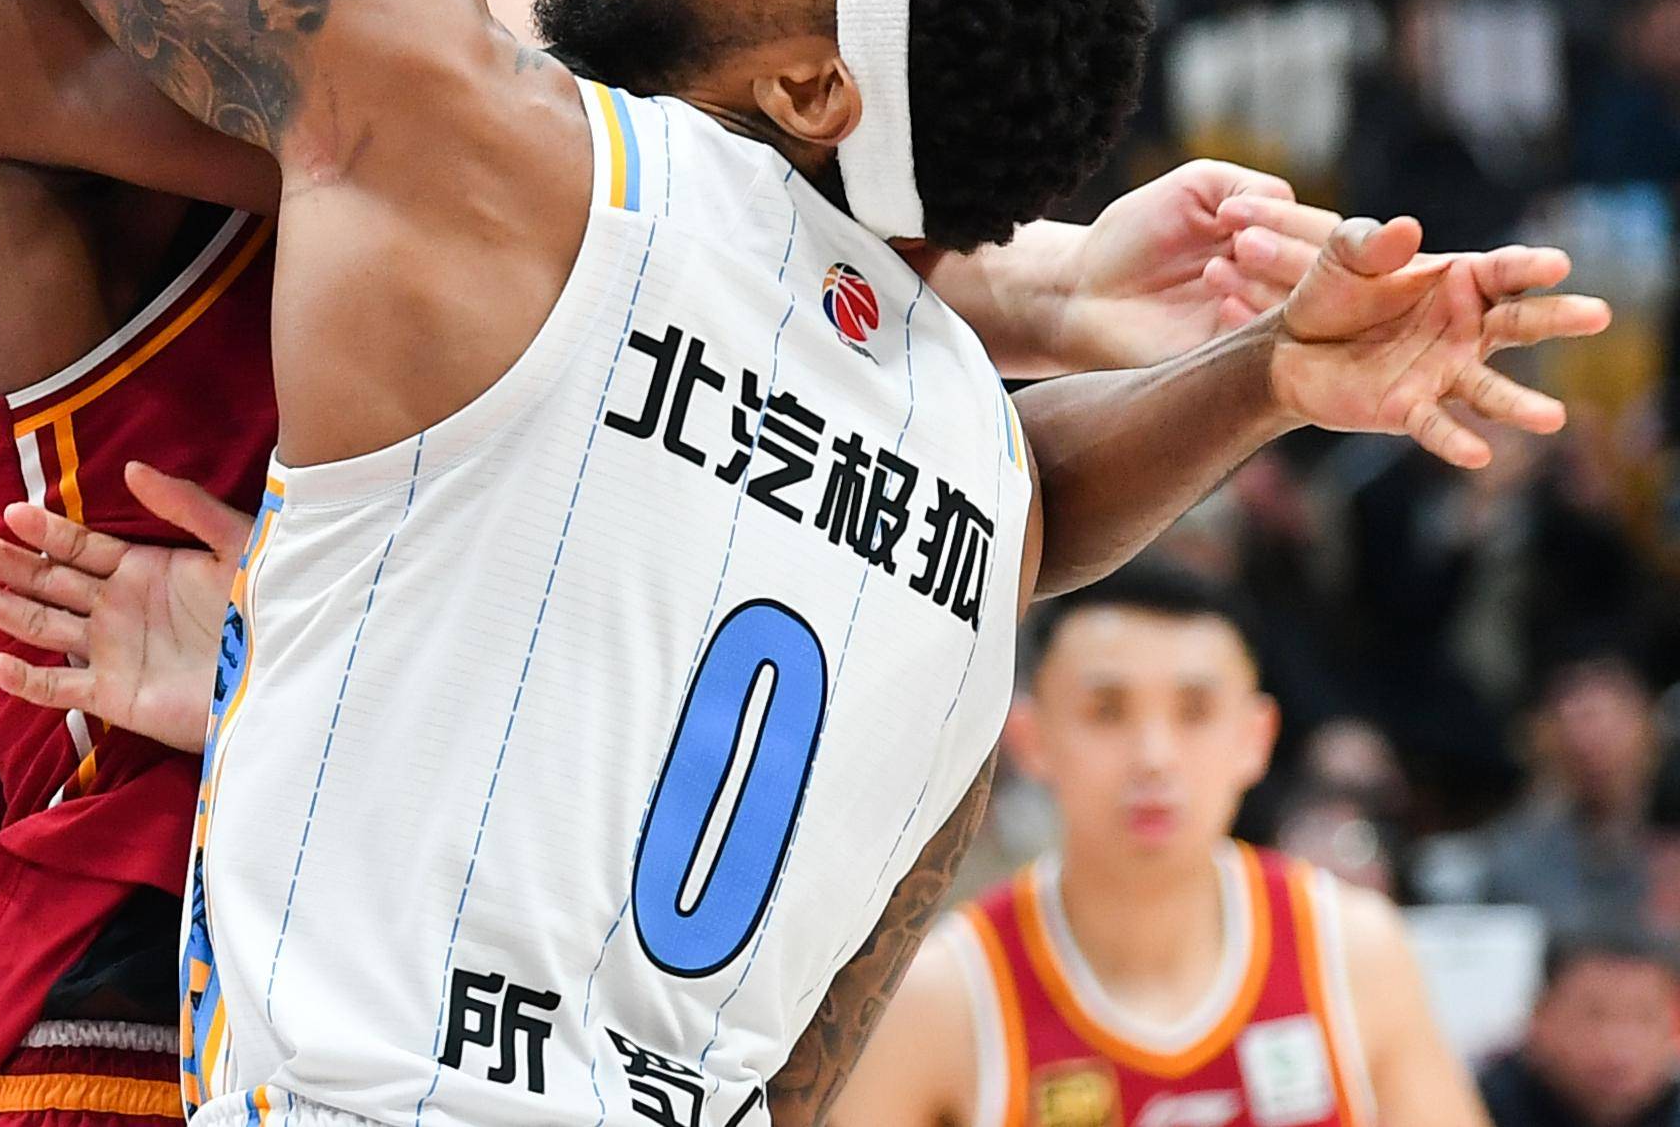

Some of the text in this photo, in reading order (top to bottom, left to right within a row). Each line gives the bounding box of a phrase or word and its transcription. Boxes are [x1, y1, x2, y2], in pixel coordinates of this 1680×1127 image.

[604, 325, 995, 633] 北汽极狐
[632, 598, 829, 979] 0
[438, 968, 765, 1127] 所罗
